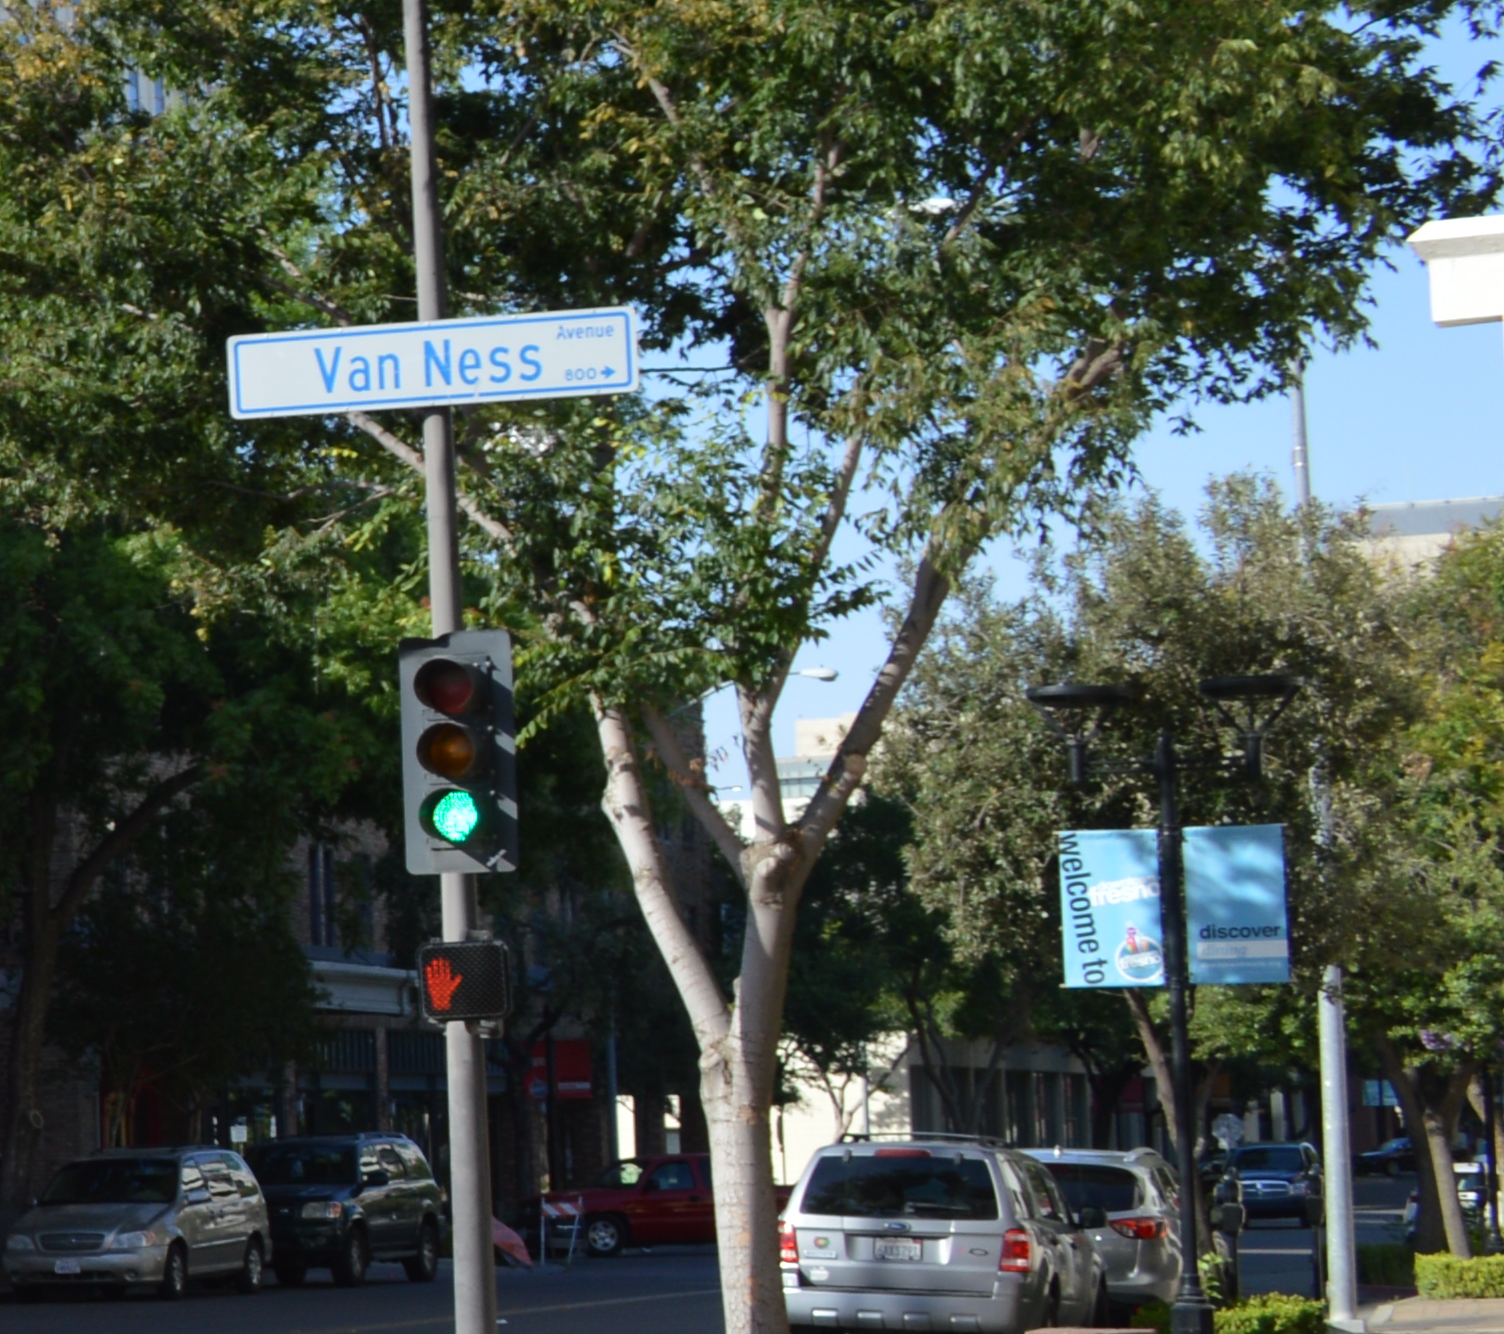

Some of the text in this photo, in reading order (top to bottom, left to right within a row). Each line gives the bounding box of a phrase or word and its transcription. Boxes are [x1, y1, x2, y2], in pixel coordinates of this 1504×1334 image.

[556, 322, 615, 340] Avenue
[314, 339, 543, 394] Van Ness
[564, 366, 597, 381] 800
[1088, 882, 1160, 907] fresno
[1059, 833, 1108, 985] welcome to
[1199, 924, 1281, 939] discover
